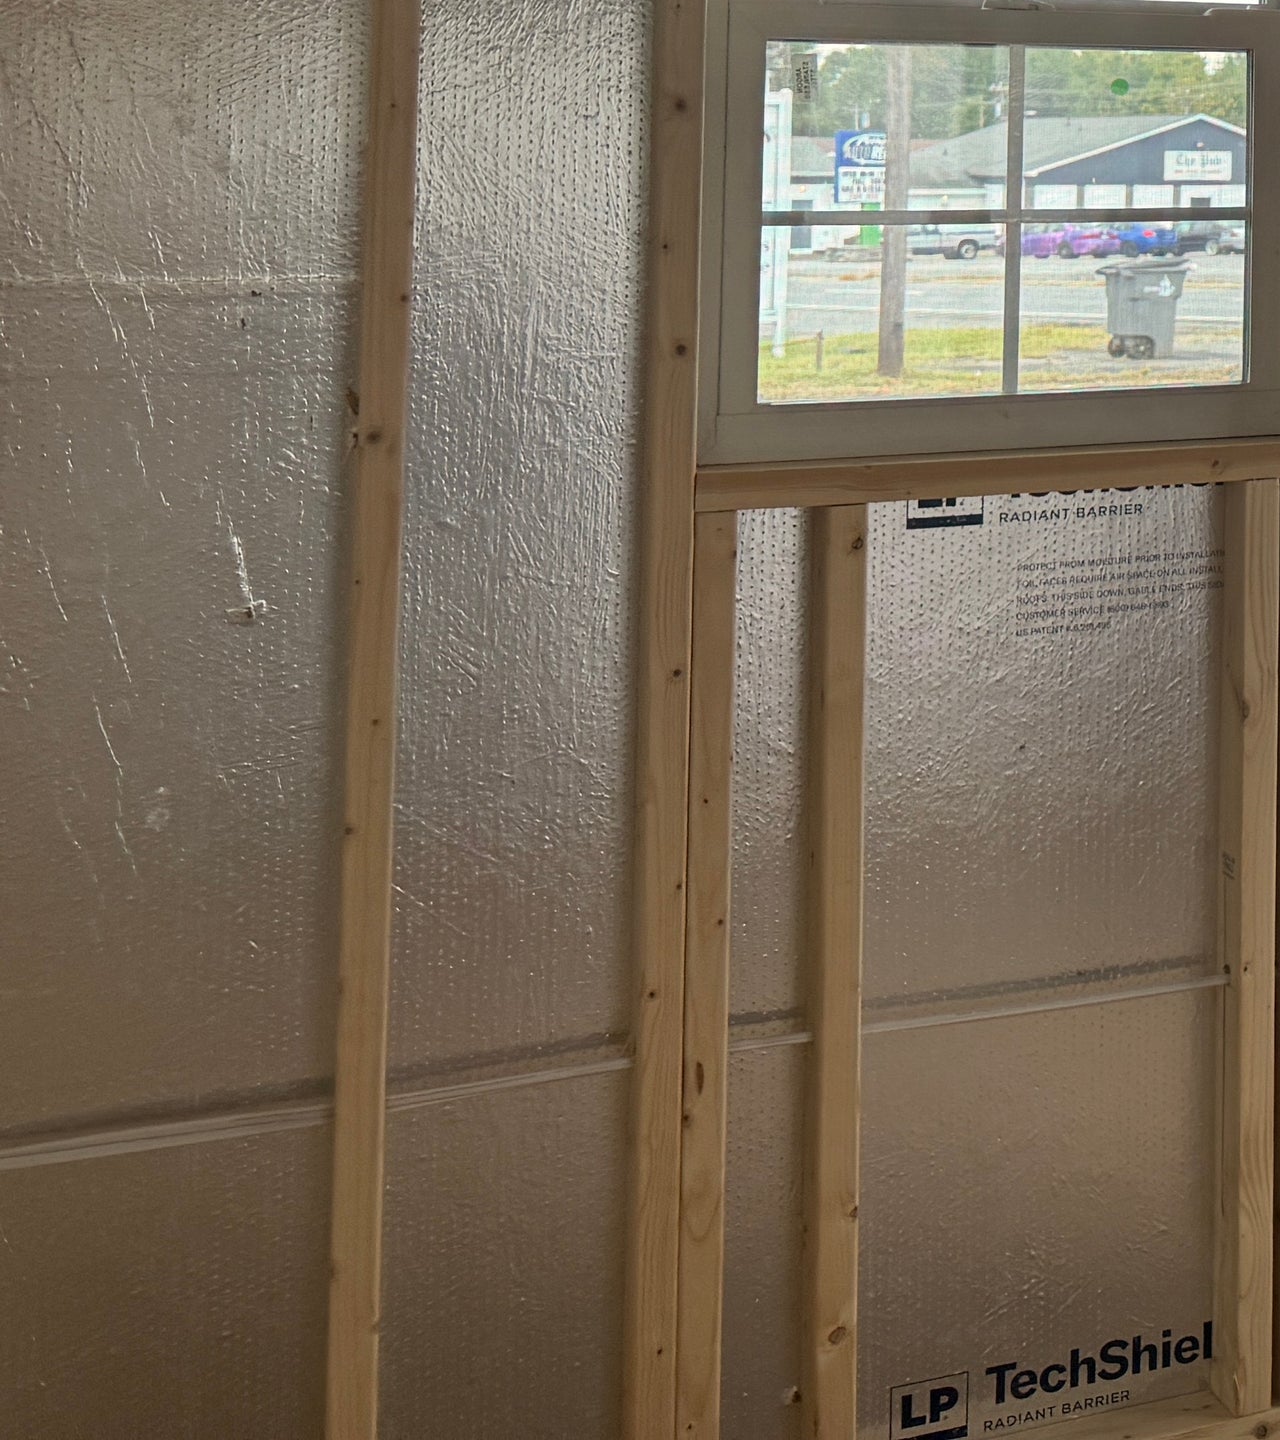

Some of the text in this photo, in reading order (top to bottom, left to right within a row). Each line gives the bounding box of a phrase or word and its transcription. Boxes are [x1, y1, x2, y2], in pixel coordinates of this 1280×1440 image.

[999, 502, 1144, 524] RADIANT BARRIER
[1135, 553, 1161, 563] PRIOR
[900, 1320, 1213, 1430] LP TechShiel
[983, 1389, 1131, 1433] RADIANT BARRIER
